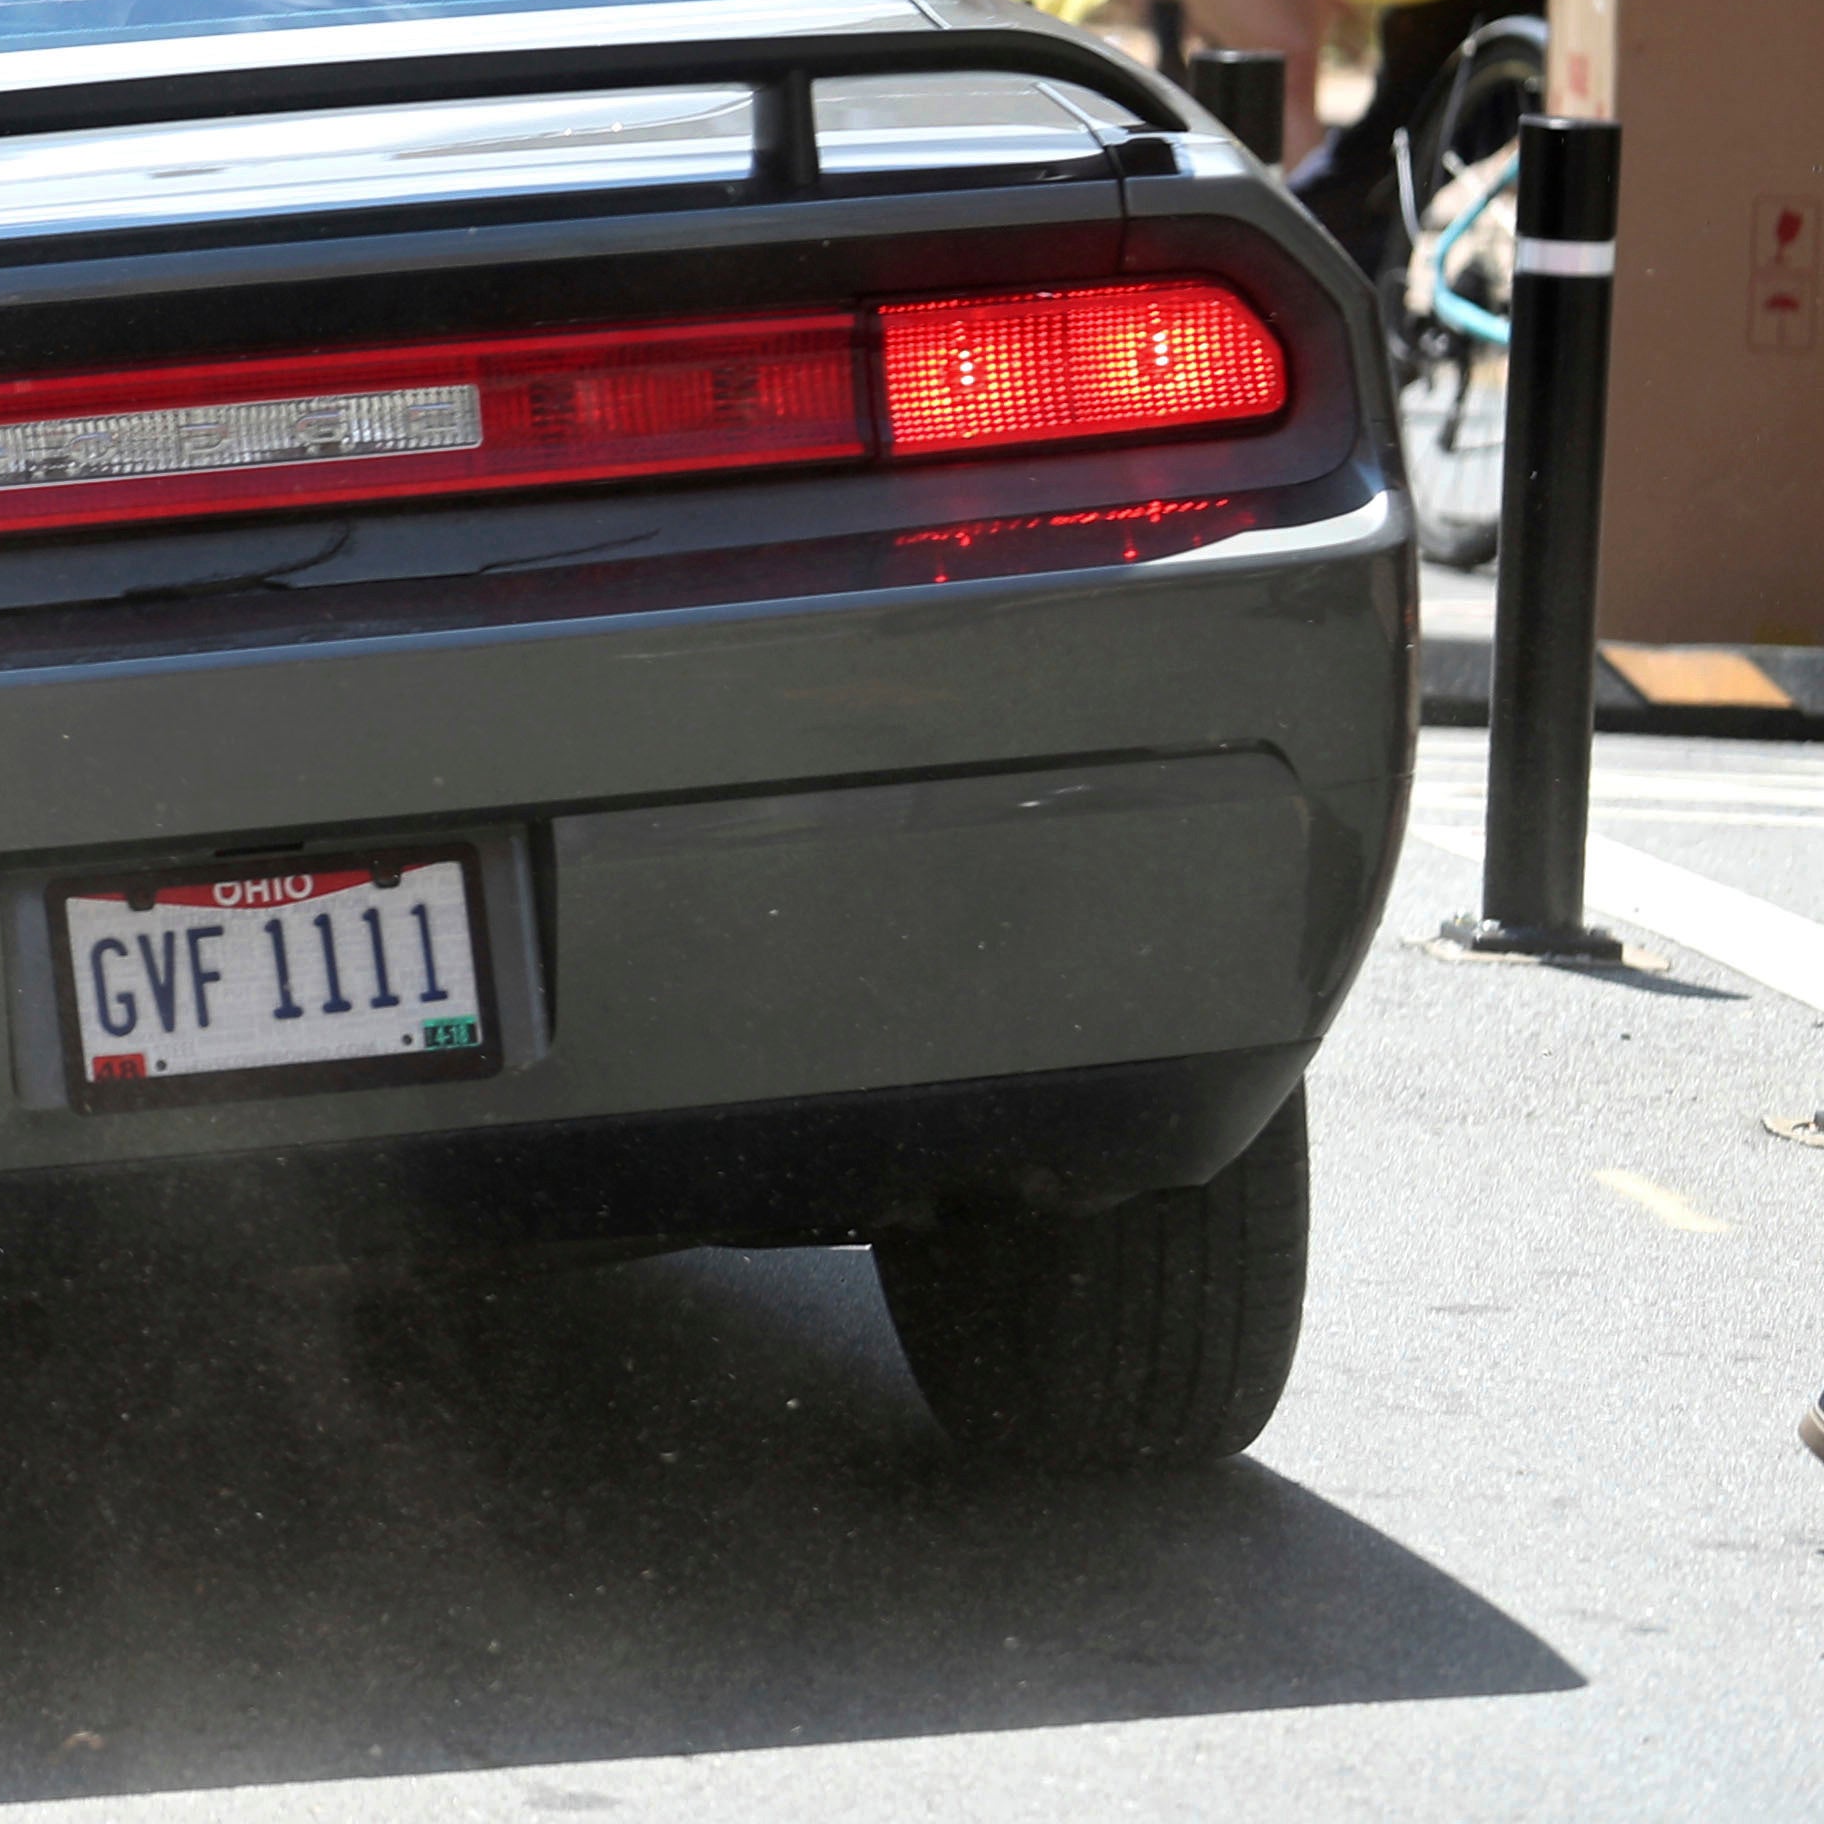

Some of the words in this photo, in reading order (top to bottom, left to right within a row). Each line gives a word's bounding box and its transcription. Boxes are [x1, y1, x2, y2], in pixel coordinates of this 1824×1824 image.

[213, 874, 315, 907] OHIO
[90, 925, 224, 1038] GVF
[263, 902, 449, 1020] 1111
